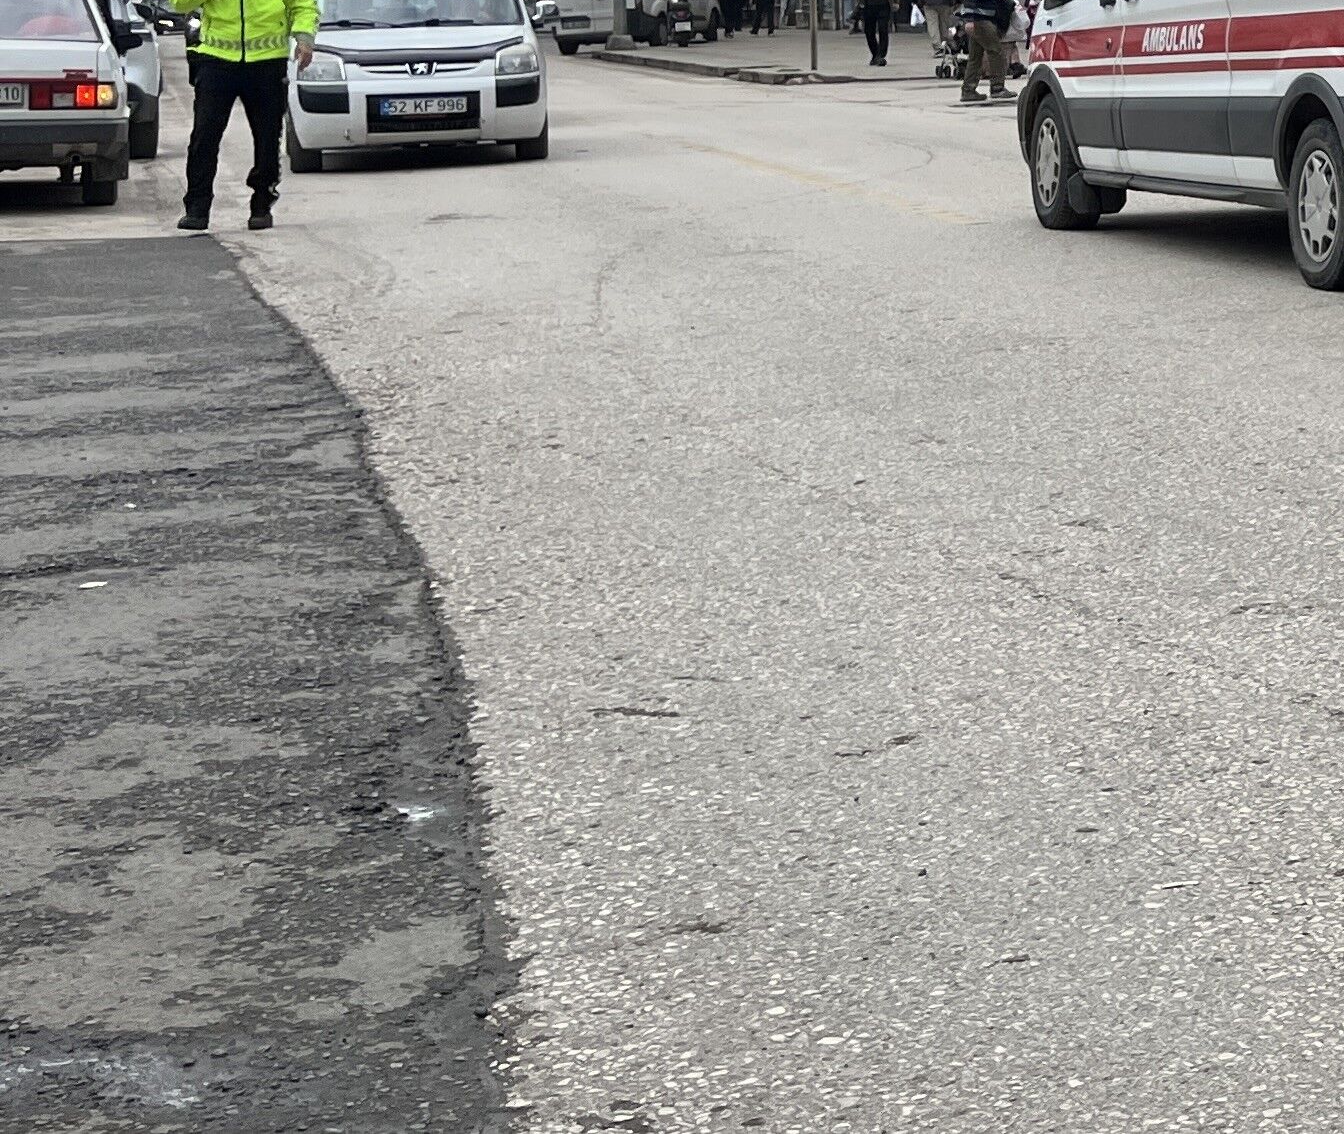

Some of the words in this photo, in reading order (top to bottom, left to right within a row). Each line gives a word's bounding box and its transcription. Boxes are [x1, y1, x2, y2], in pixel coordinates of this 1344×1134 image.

[1141, 23, 1206, 53] AMBULANS
[0, 86, 20, 101] 10
[413, 100, 434, 113] KF
[437, 98, 465, 112] 996
